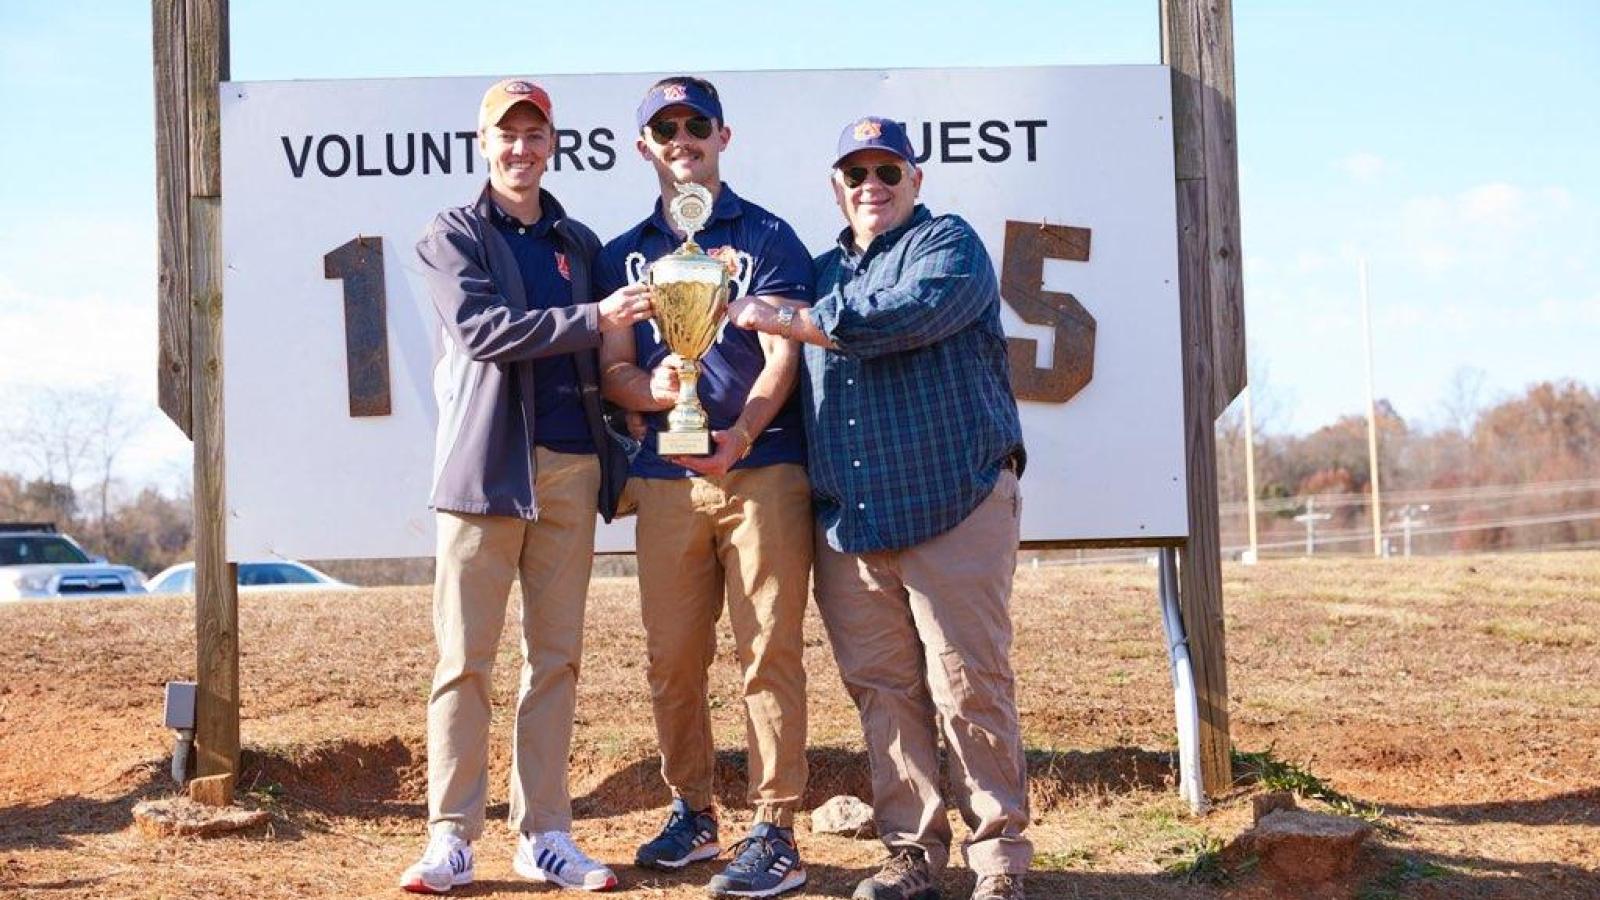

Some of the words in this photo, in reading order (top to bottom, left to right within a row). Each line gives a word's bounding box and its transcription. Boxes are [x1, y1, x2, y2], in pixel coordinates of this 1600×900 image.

[281, 127, 617, 178] VOLUNTRS
[898, 120, 1048, 163] UEST
[324, 236, 392, 417] 1
[1000, 220, 1097, 403] 5
